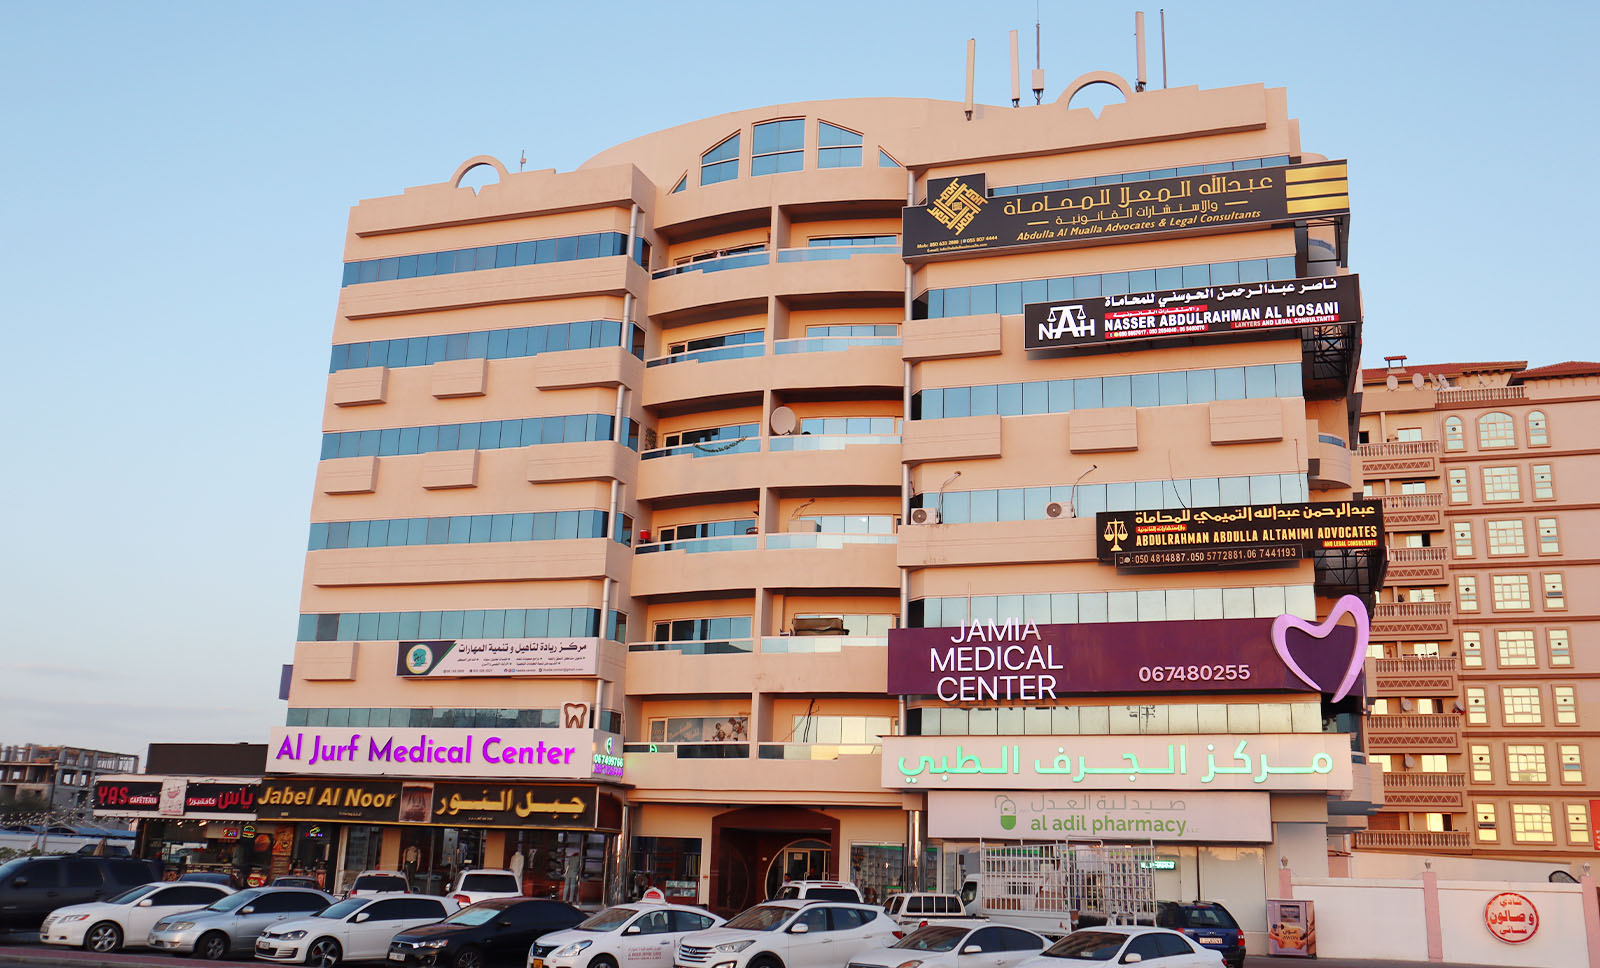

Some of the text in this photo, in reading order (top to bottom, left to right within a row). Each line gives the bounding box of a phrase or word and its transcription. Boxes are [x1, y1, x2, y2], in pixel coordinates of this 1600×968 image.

[1198, 174, 1272, 196] عبدالله
[1004, 188, 1110, 216] للمحاماة
[1016, 209, 1262, 241] Abdulla Al Mualla Advocates & Legal Consultants
[1055, 208, 1132, 226] القانونية
[1104, 278, 1338, 308] ناصر عبدالرحمن الحوسني للمحاماة
[1104, 302, 1339, 332] NASSER ABDULRAHMAN AL HOSANI
[1294, 316, 1334, 324] CONSULTANTS
[1135, 502, 1376, 524] عبدالرحمن عبدالله التميمي للمحاماة
[1136, 526, 1377, 546] ABDULRAHMAN ABDULLA ALTAMIMI ADVOCATES
[1260, 548, 1296, 558] 7441193
[950, 616, 1042, 644] JAMIA
[458, 644, 487, 654] المهارات
[488, 644, 509, 654] تنمية
[559, 642, 587, 653] مركز
[930, 644, 1064, 672] MEDICAL
[1138, 665, 1250, 682] 067480255
[937, 675, 1057, 702] CENTER
[276, 733, 576, 765] Al Jurf Medical Center
[898, 740, 1333, 784] مركز الجرف الطبي
[98, 786, 128, 805] YAS
[218, 788, 253, 809] ياس
[258, 786, 397, 808] Jabel Al Noor
[435, 788, 586, 820] جبل النور
[1031, 794, 1186, 814] صيدلية العدل
[1031, 815, 1047, 831] al
[1052, 815, 1087, 831] adil
[1093, 815, 1187, 837] pharmacy
[1490, 910, 1534, 926] و صالون
